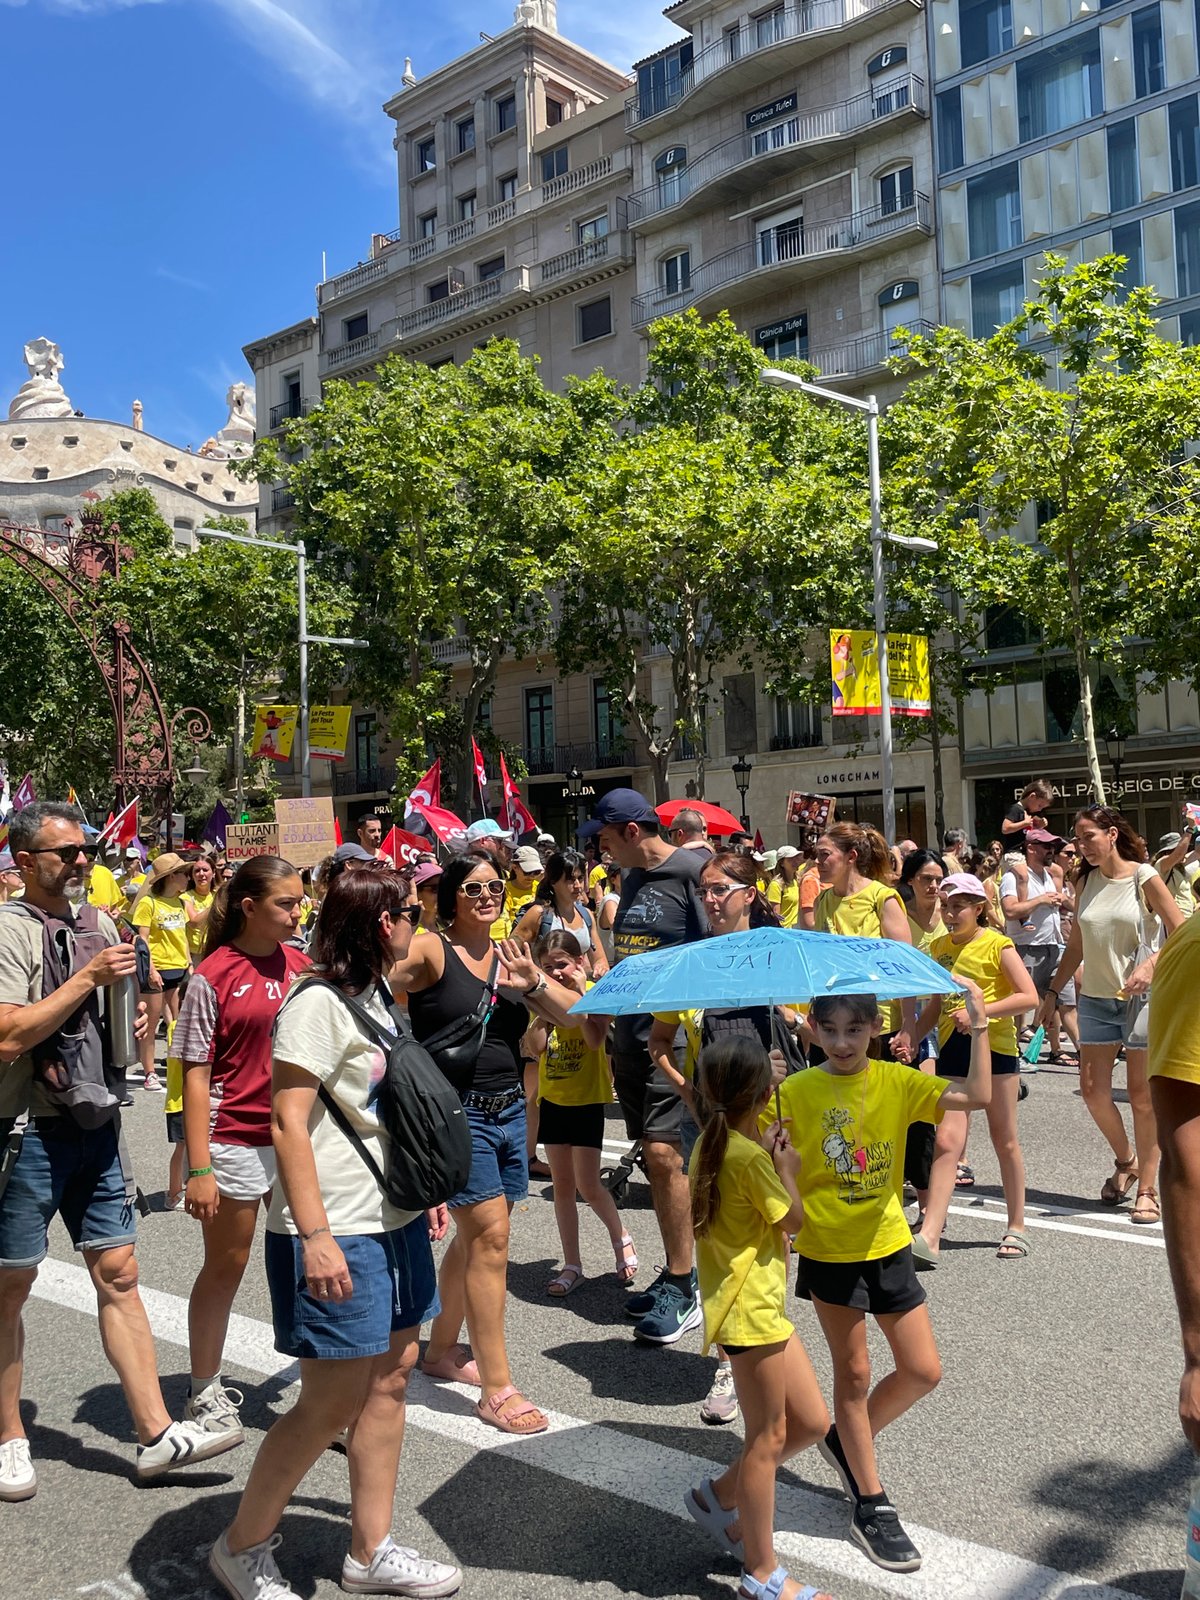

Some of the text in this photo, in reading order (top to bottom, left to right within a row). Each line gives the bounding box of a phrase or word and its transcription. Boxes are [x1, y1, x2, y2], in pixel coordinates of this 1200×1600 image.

[888, 639, 911, 651] La Festa
[889, 651, 898, 660] del
[817, 771, 880, 784] LONGCHAM
[562, 786, 596, 797] PDA
[1014, 785, 1070, 800] RAL
[1160, 776, 1185, 791] DE
[227, 825, 277, 838] LLUITANT
[876, 961, 912, 976] EN
[265, 981, 282, 999] 21
